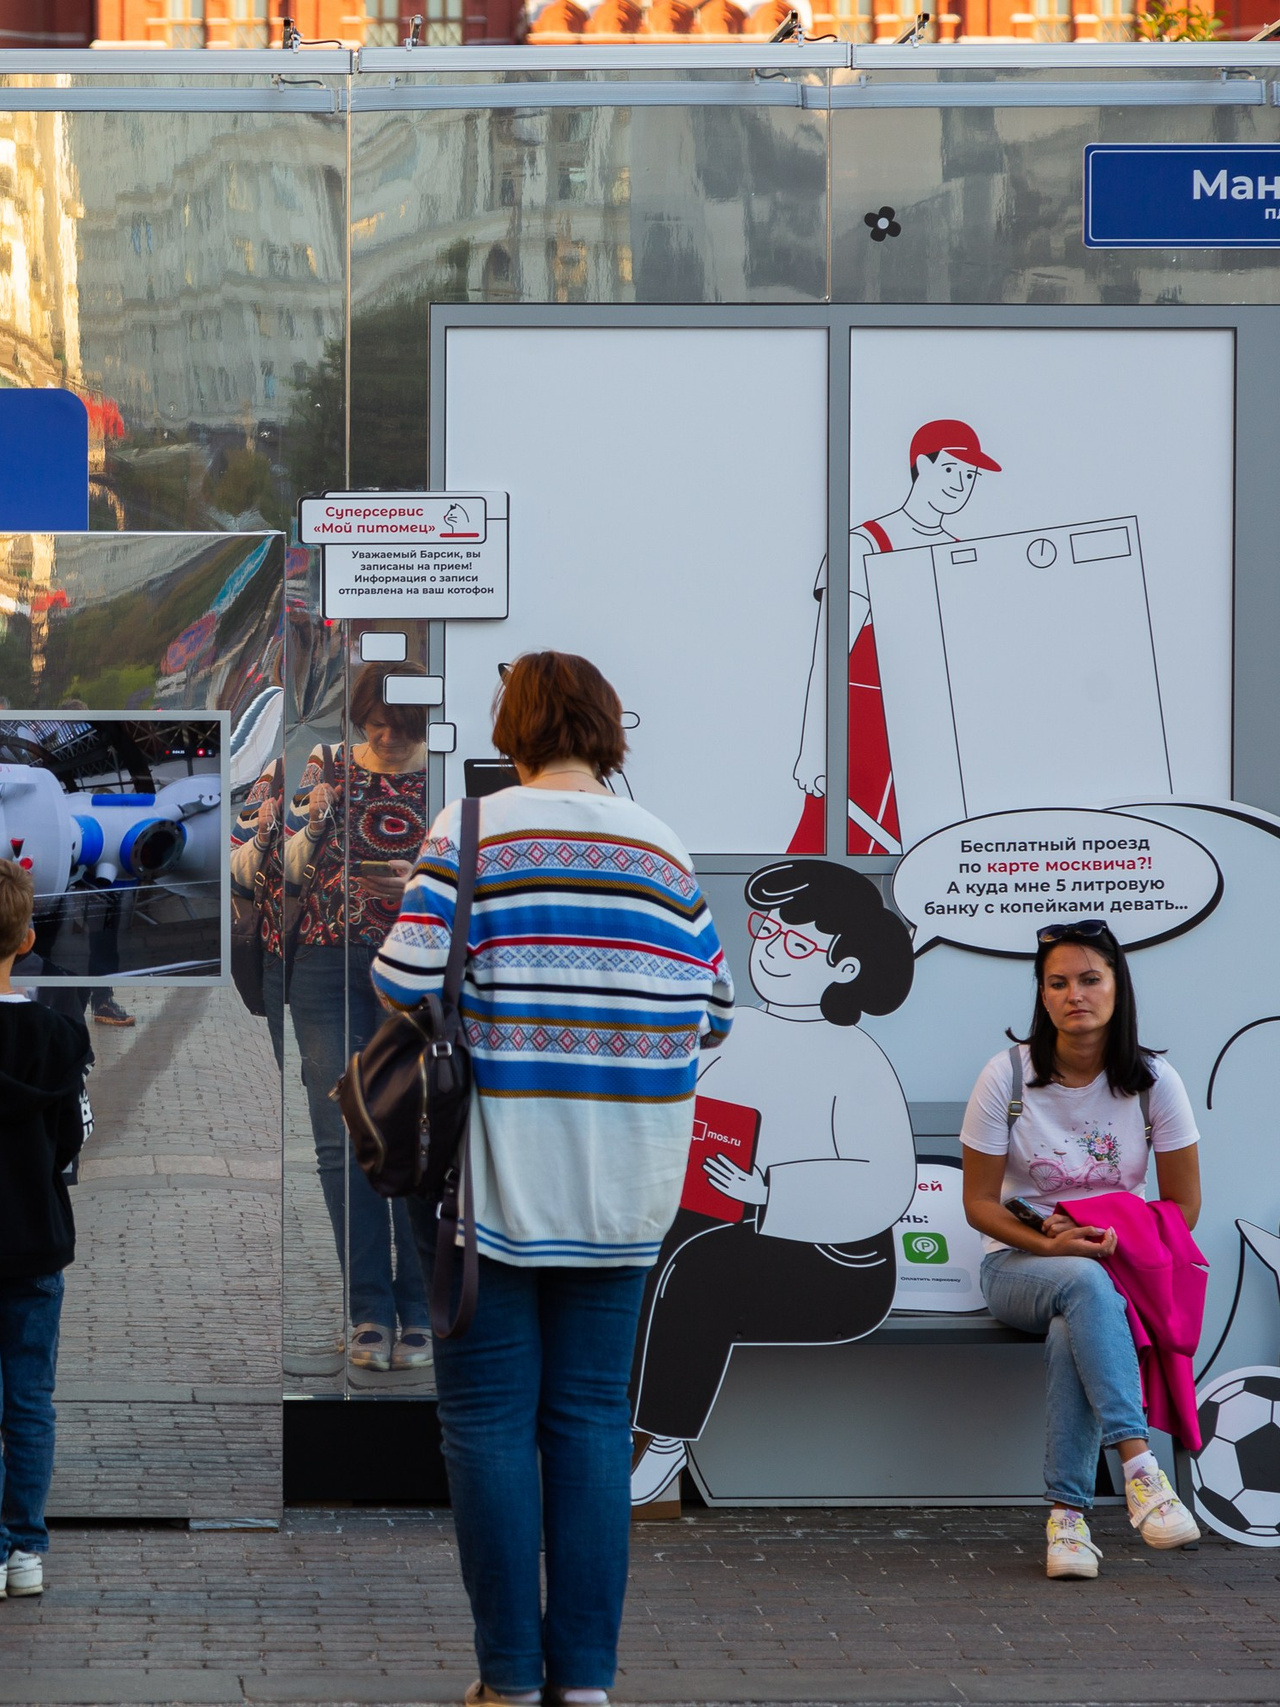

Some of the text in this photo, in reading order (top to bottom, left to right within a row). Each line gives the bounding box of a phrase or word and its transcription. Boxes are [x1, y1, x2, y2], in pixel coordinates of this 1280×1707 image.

[325, 506, 424, 520] Суперсервис
[313, 522, 436, 535] «Мой питомец»
[351, 549, 481, 560] Уважаемый Барсик, вы
[360, 561, 473, 573] записаны на прием!
[354, 573, 479, 585] Информация о записи
[338, 586, 495, 597] отправлена на ваш котофон
[960, 836, 1151, 856] Бесплатный проезд
[958, 857, 1152, 876] по карте москвича?!
[947, 878, 1165, 896] А куда мне 5 литровую
[924, 900, 980, 917] банку
[985, 903, 995, 914] с
[1000, 897, 1105, 915] копейками
[707, 1130, 741, 1147] mos.ru
[917, 1180, 943, 1192] ей
